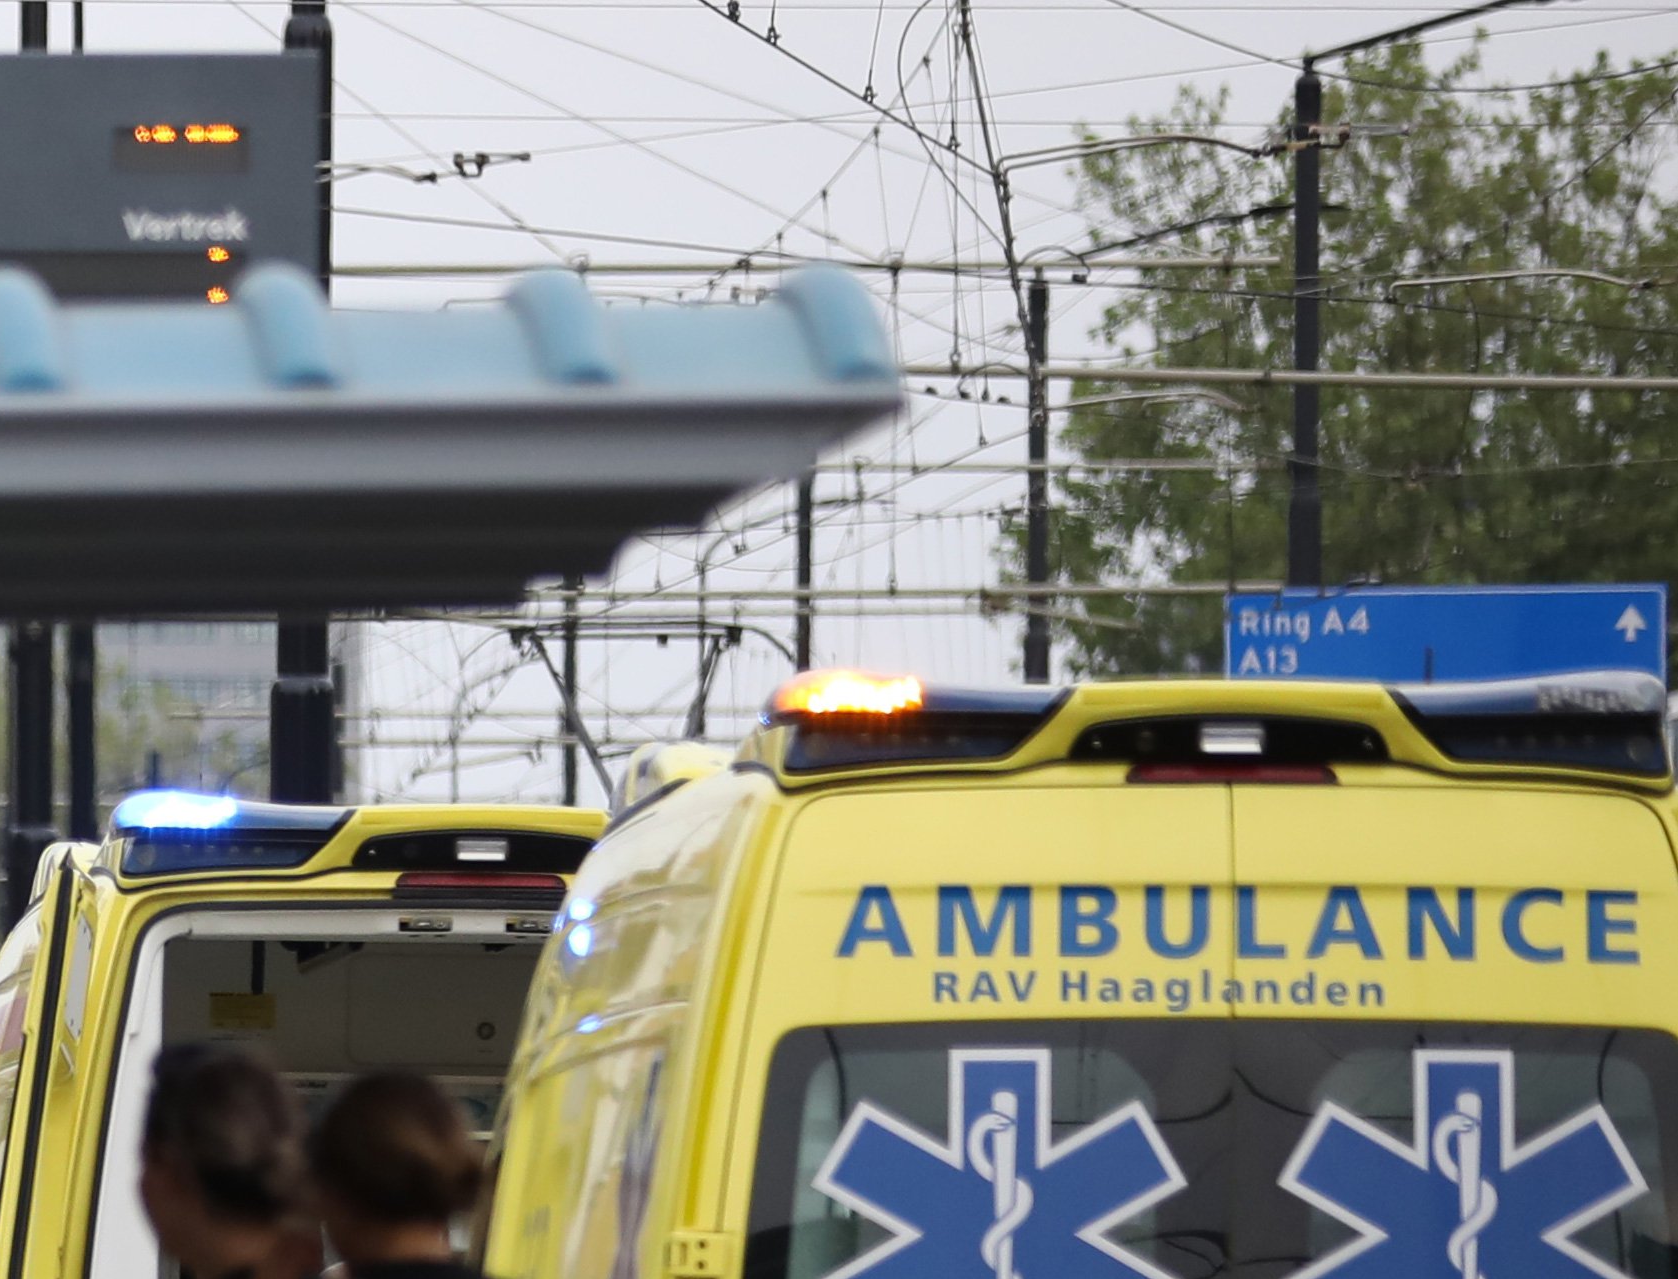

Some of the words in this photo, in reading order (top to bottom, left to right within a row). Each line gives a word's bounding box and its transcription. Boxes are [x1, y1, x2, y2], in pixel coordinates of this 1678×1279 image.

[123, 209, 249, 242] Vertrek
[1240, 607, 1311, 643] Ring
[1322, 605, 1369, 635] A4
[1239, 645, 1298, 675] A13
[835, 883, 1642, 964] AMBULANCE
[933, 970, 1038, 1003] RAV
[1060, 970, 1387, 1012] Haaglanden
